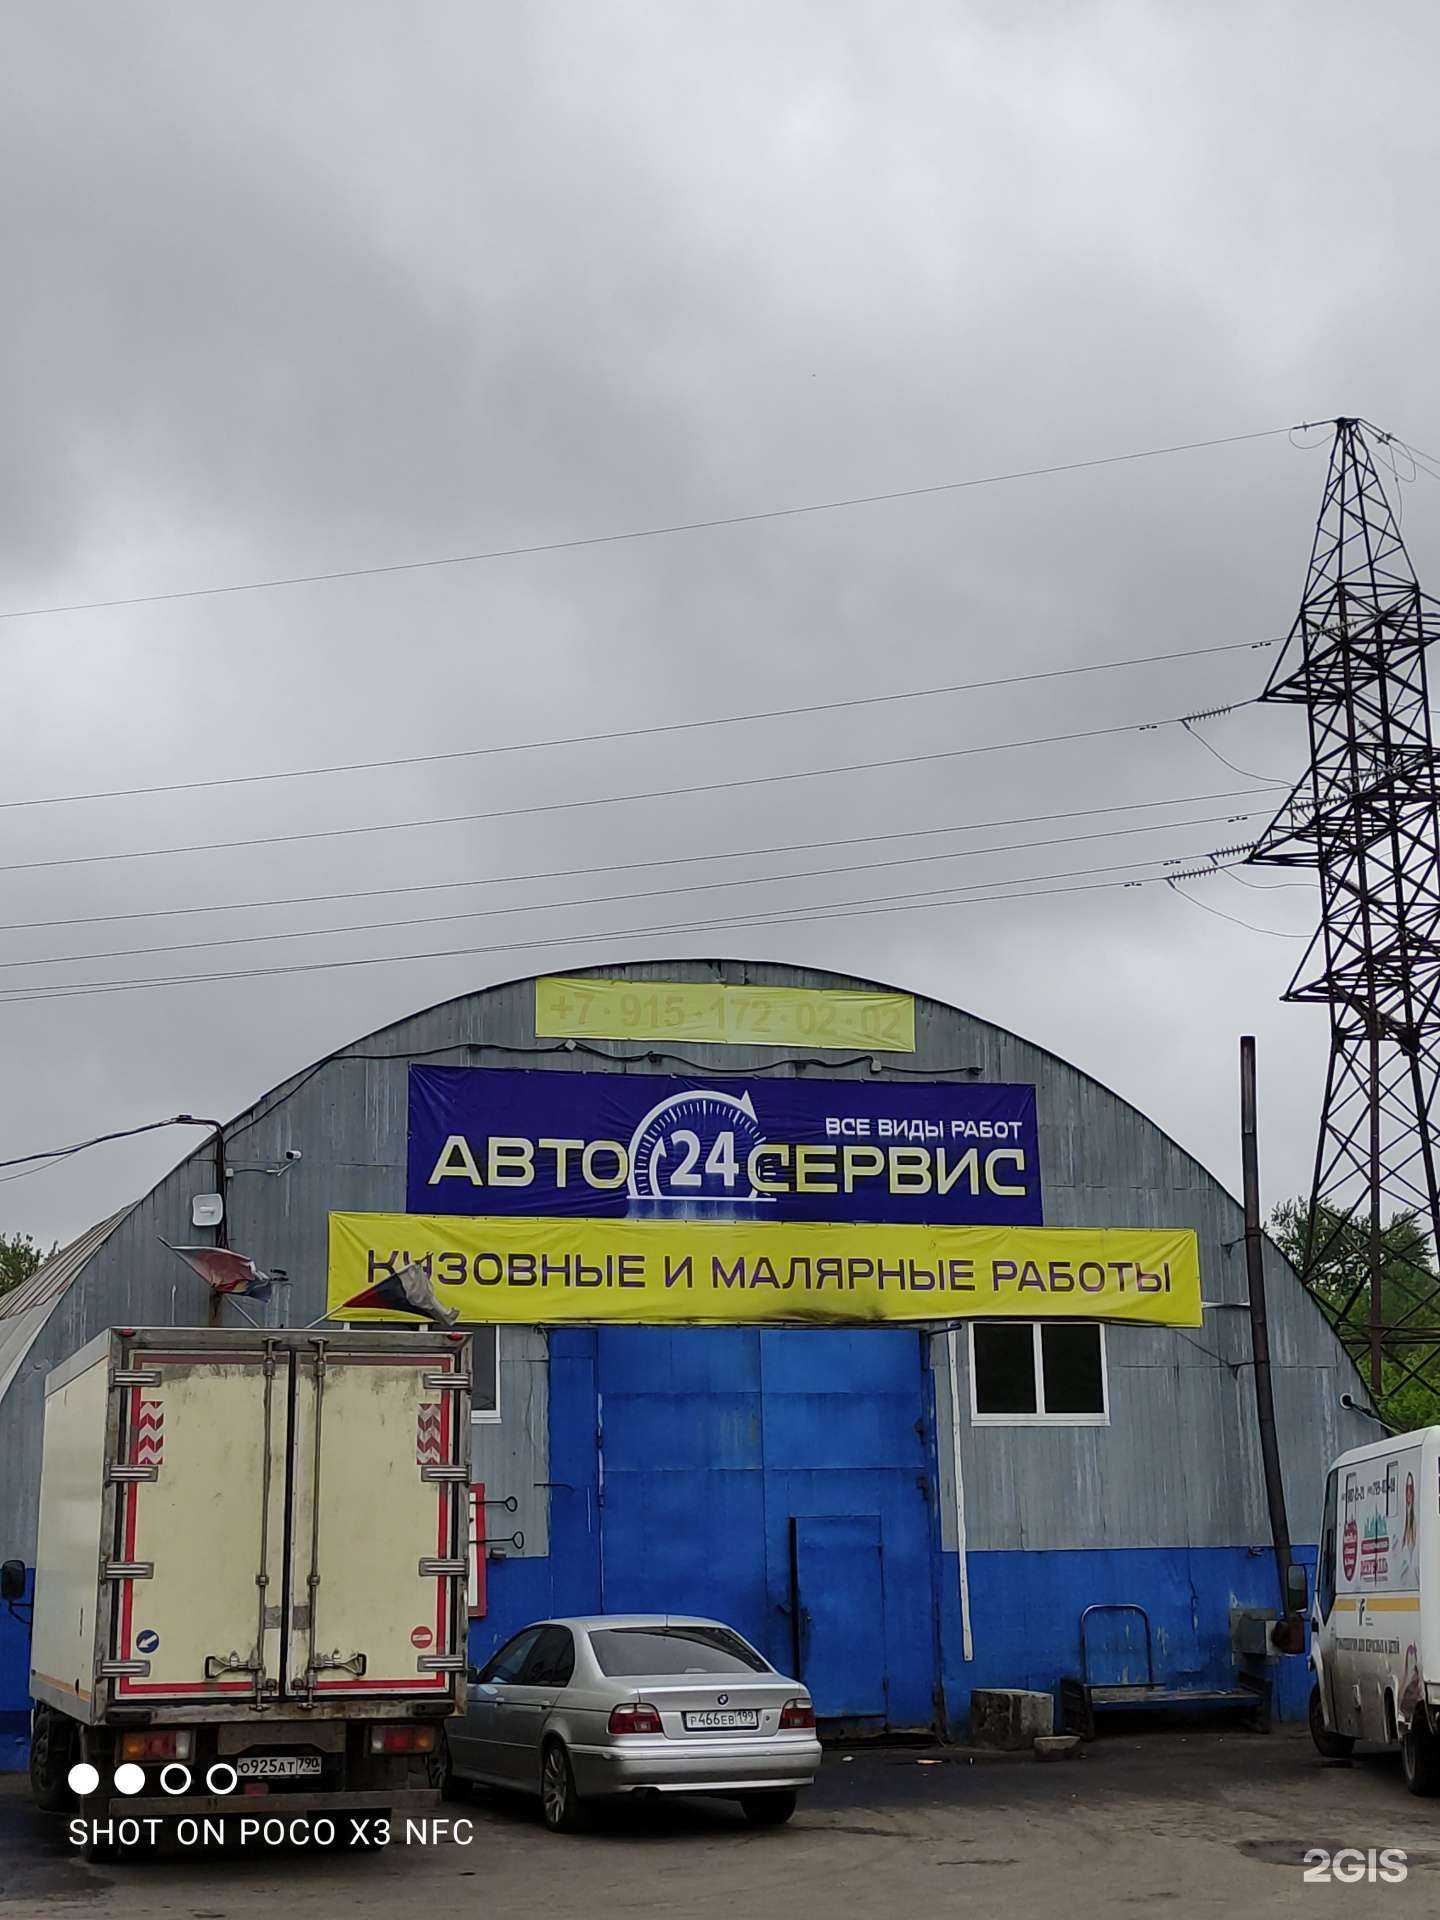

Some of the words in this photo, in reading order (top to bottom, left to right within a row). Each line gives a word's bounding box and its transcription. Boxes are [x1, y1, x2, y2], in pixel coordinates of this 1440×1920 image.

[825, 1117, 871, 1136] ВСЕ
[878, 1118, 944, 1142] ВИДЫ
[951, 1120, 1023, 1140] РАБОТ
[428, 1135, 630, 1190] АВТО
[669, 1129, 739, 1187] 24
[747, 1143, 1027, 1196] СЕРВИС
[664, 1255, 694, 1289] И
[711, 1256, 976, 1292] МАЛЯРНЫЕ
[992, 1260, 1172, 1293] РАБОТЫ
